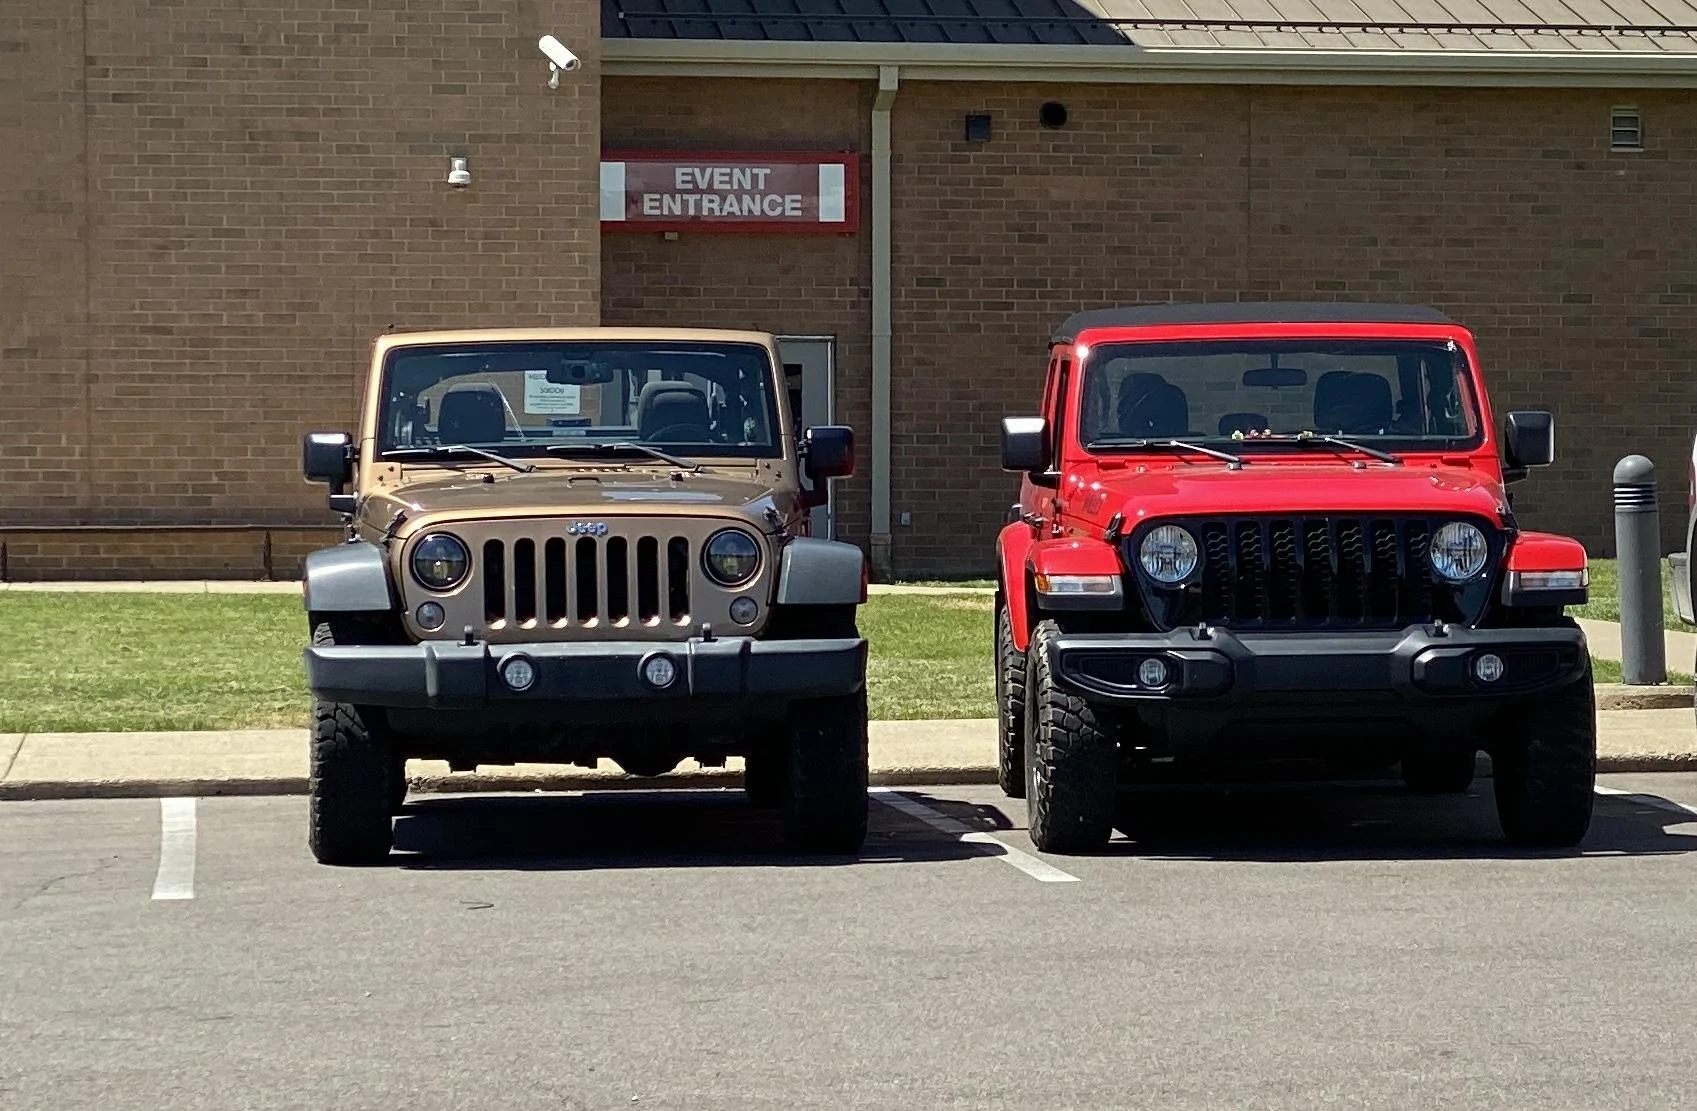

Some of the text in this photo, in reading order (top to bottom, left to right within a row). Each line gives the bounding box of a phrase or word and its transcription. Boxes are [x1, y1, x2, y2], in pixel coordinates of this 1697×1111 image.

[675, 167, 771, 189] EVENT
[643, 194, 802, 216] ENTRANCE
[566, 521, 608, 537] Jeep
